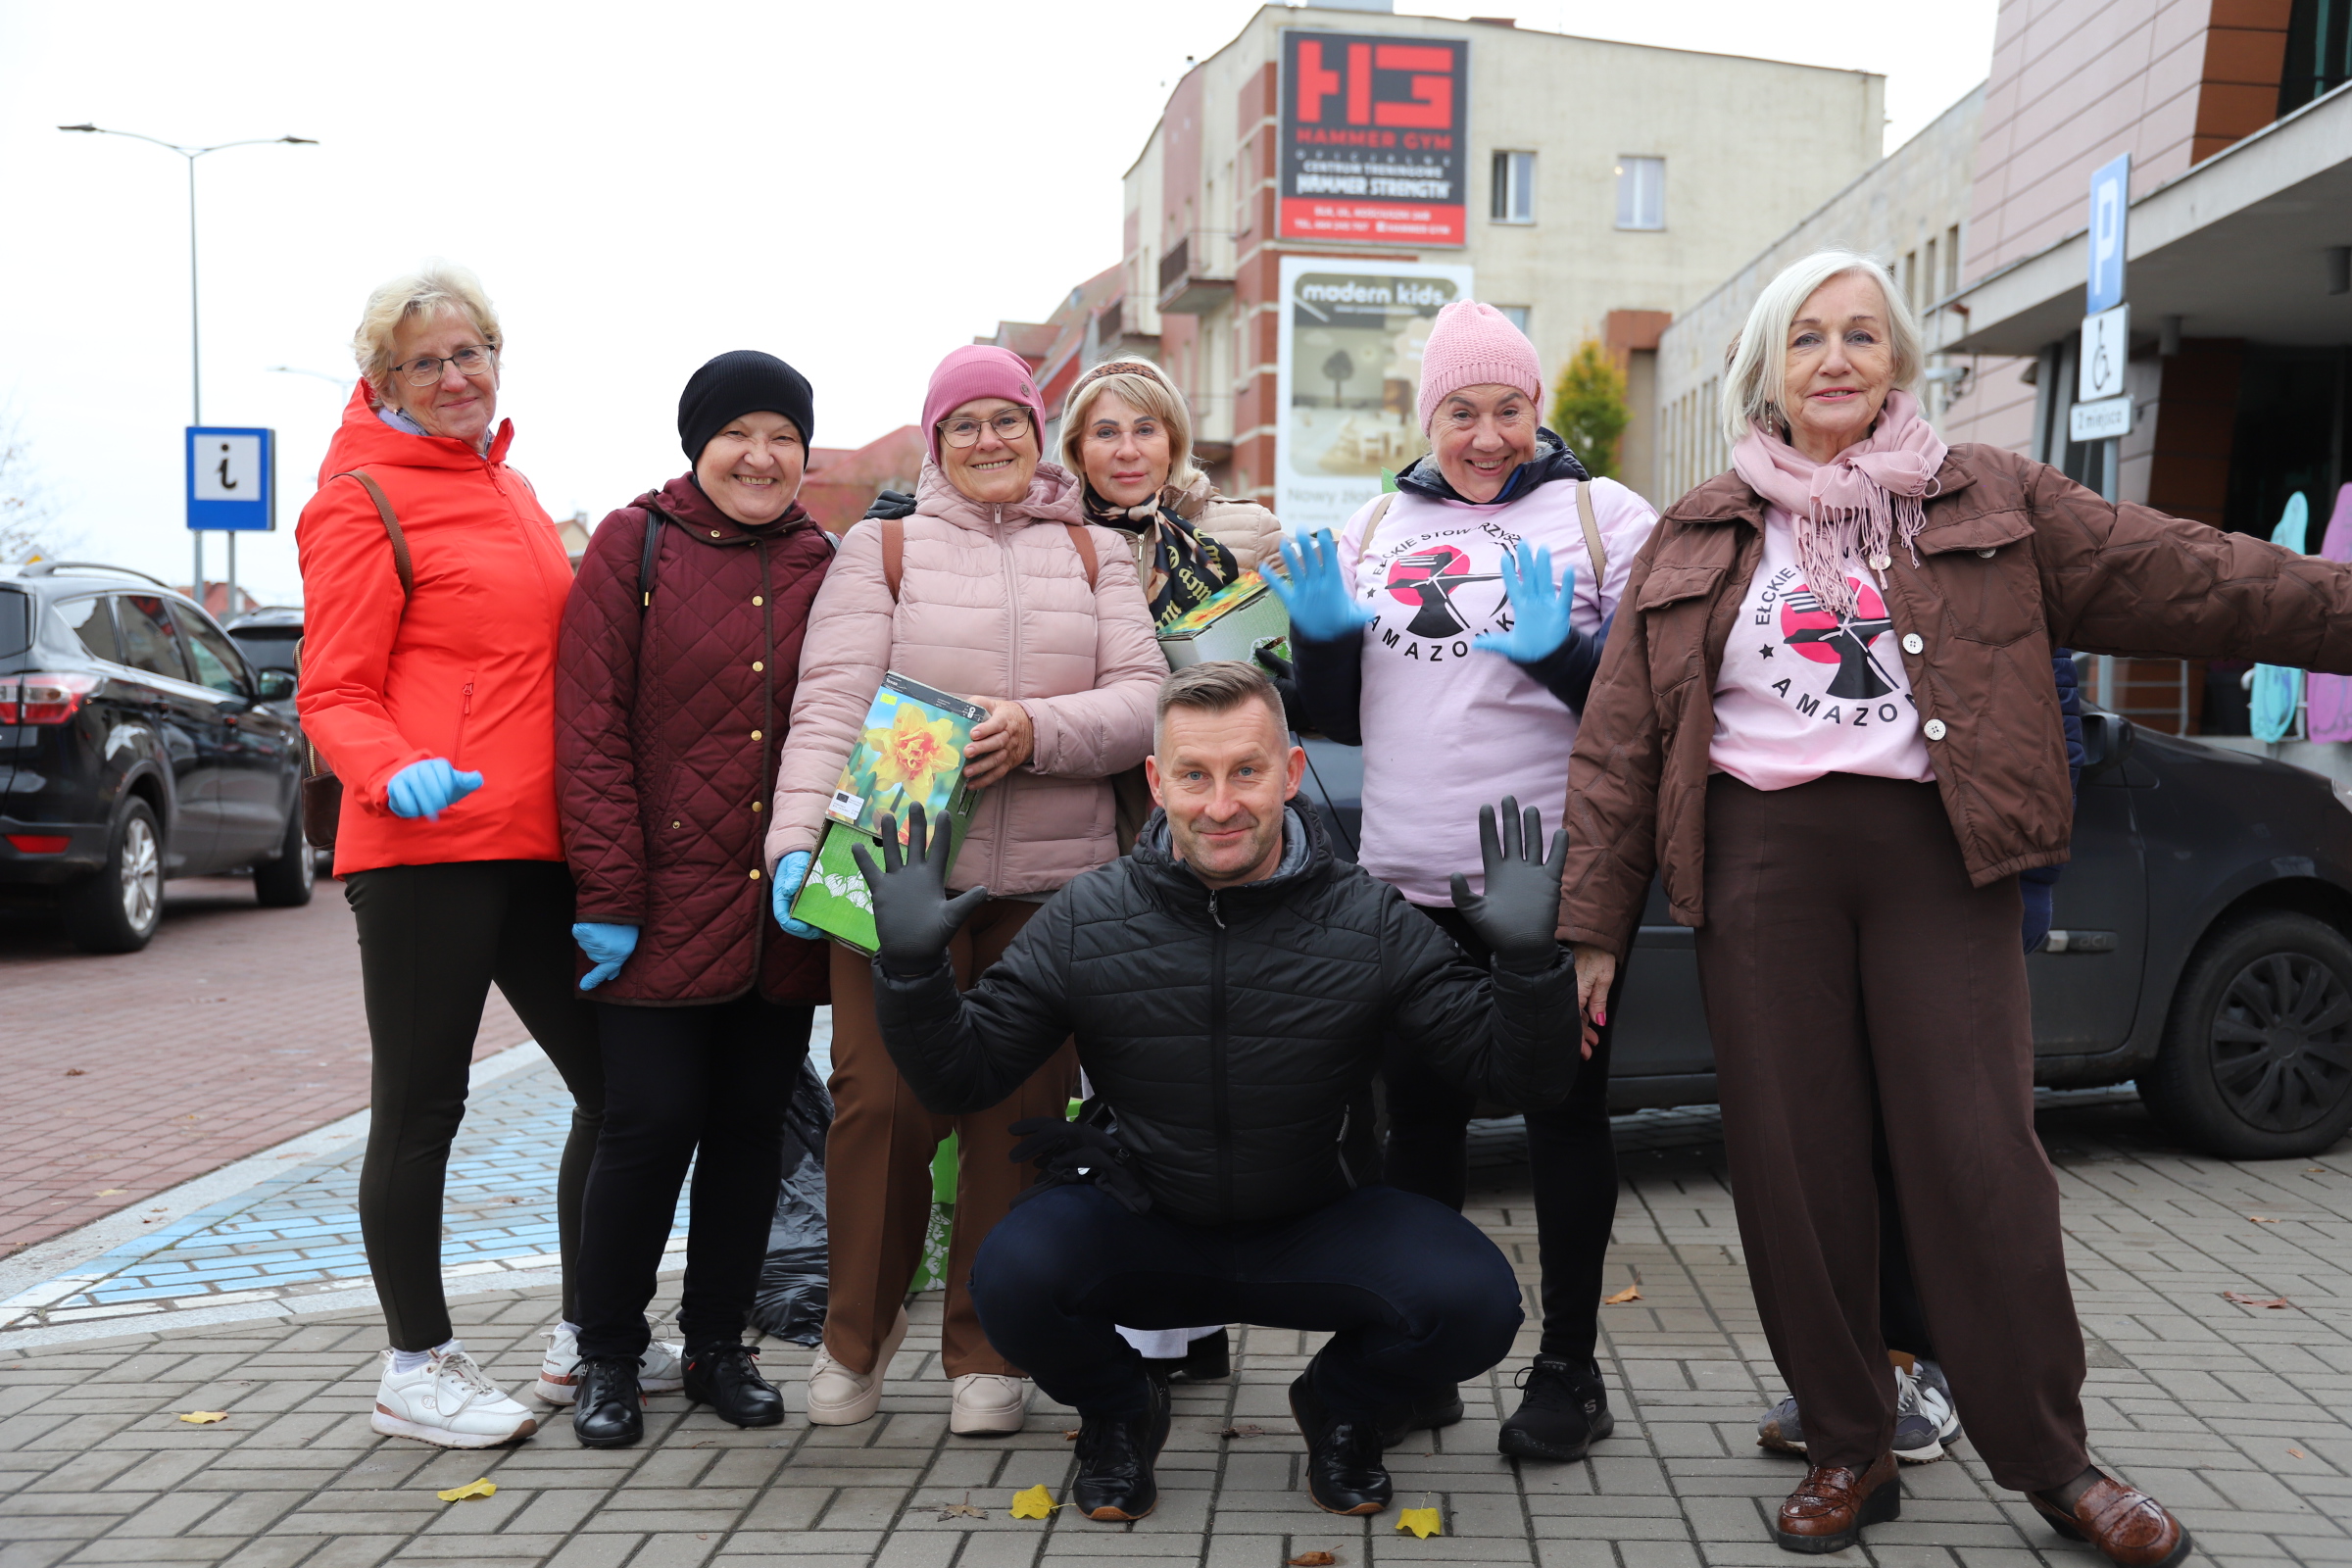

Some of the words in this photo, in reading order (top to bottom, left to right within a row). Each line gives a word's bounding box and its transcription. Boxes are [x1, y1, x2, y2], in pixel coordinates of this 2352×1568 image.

[1296, 127, 1396, 149] HAMMER
[1403, 132, 1452, 151] GYM
[1296, 172, 1368, 195] HAMMER
[2093, 176, 2119, 296] P
[1301, 280, 1392, 304] modern
[1396, 282, 1445, 306] kids
[1755, 567, 1796, 625] EŁCKIE
